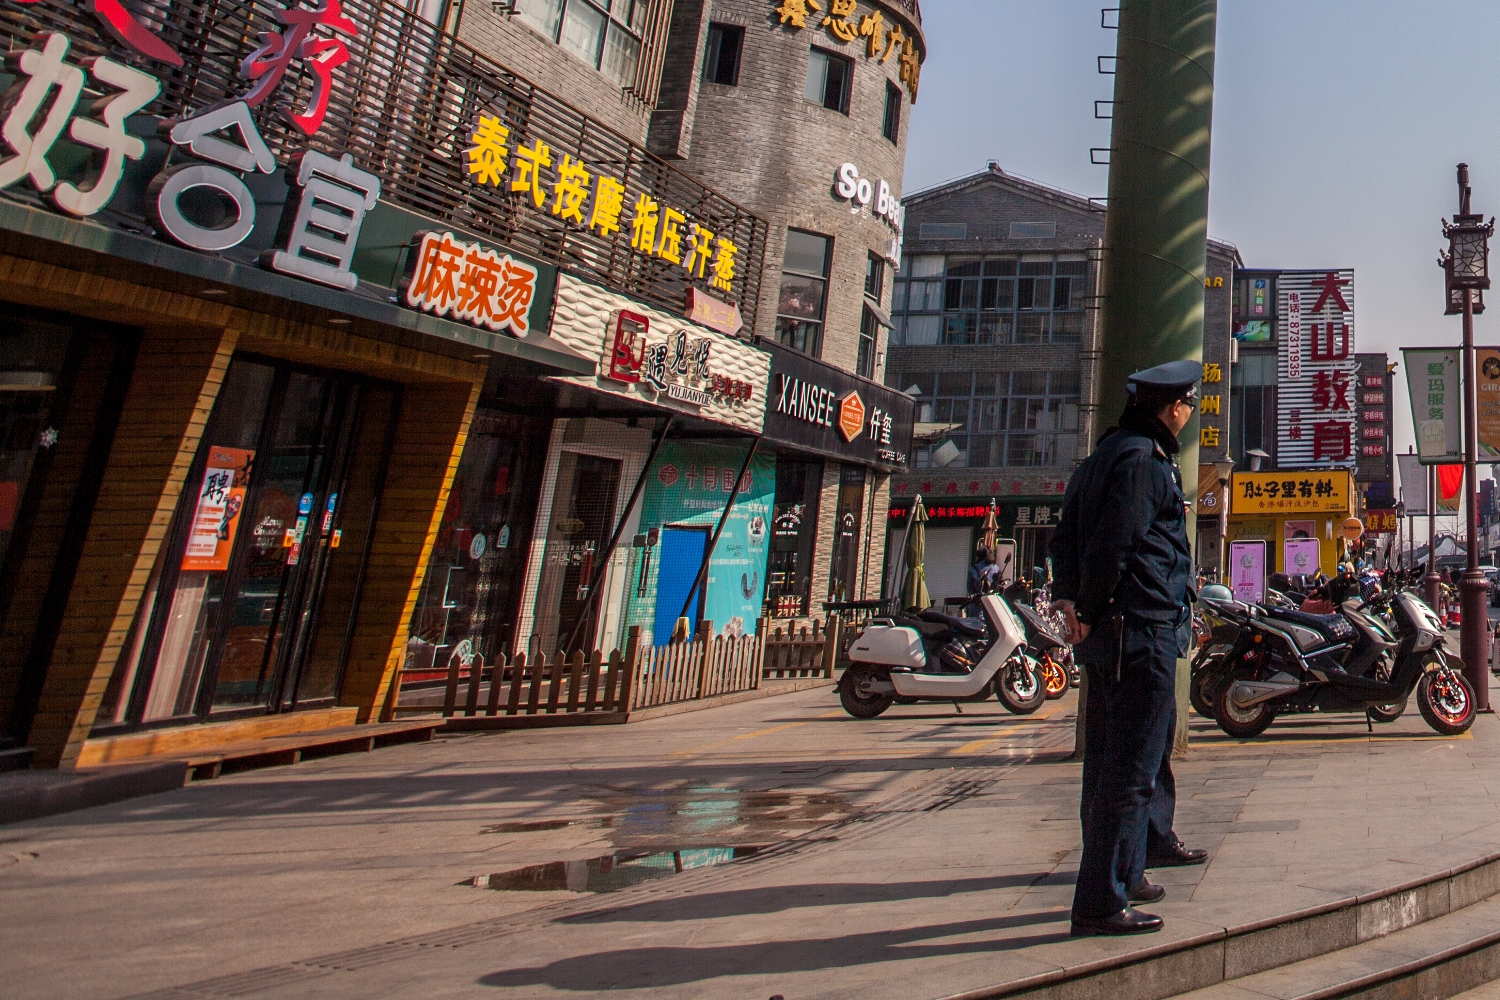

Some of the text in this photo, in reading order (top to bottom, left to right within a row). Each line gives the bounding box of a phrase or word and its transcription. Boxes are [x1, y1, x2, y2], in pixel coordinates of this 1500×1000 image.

[0, 31, 382, 291] 好合宜
[834, 162, 872, 205] So
[410, 233, 537, 333] 麻辣烫
[1311, 272, 1352, 462] 大山教育
[1426, 362, 1445, 421] 爱玛服务
[668, 385, 713, 407] YUJIANYUE
[777, 373, 836, 428] XANSEE
[1199, 361, 1222, 448] 扬州店
[201, 470, 231, 505] 聘
[1015, 505, 1051, 525] 星牌
